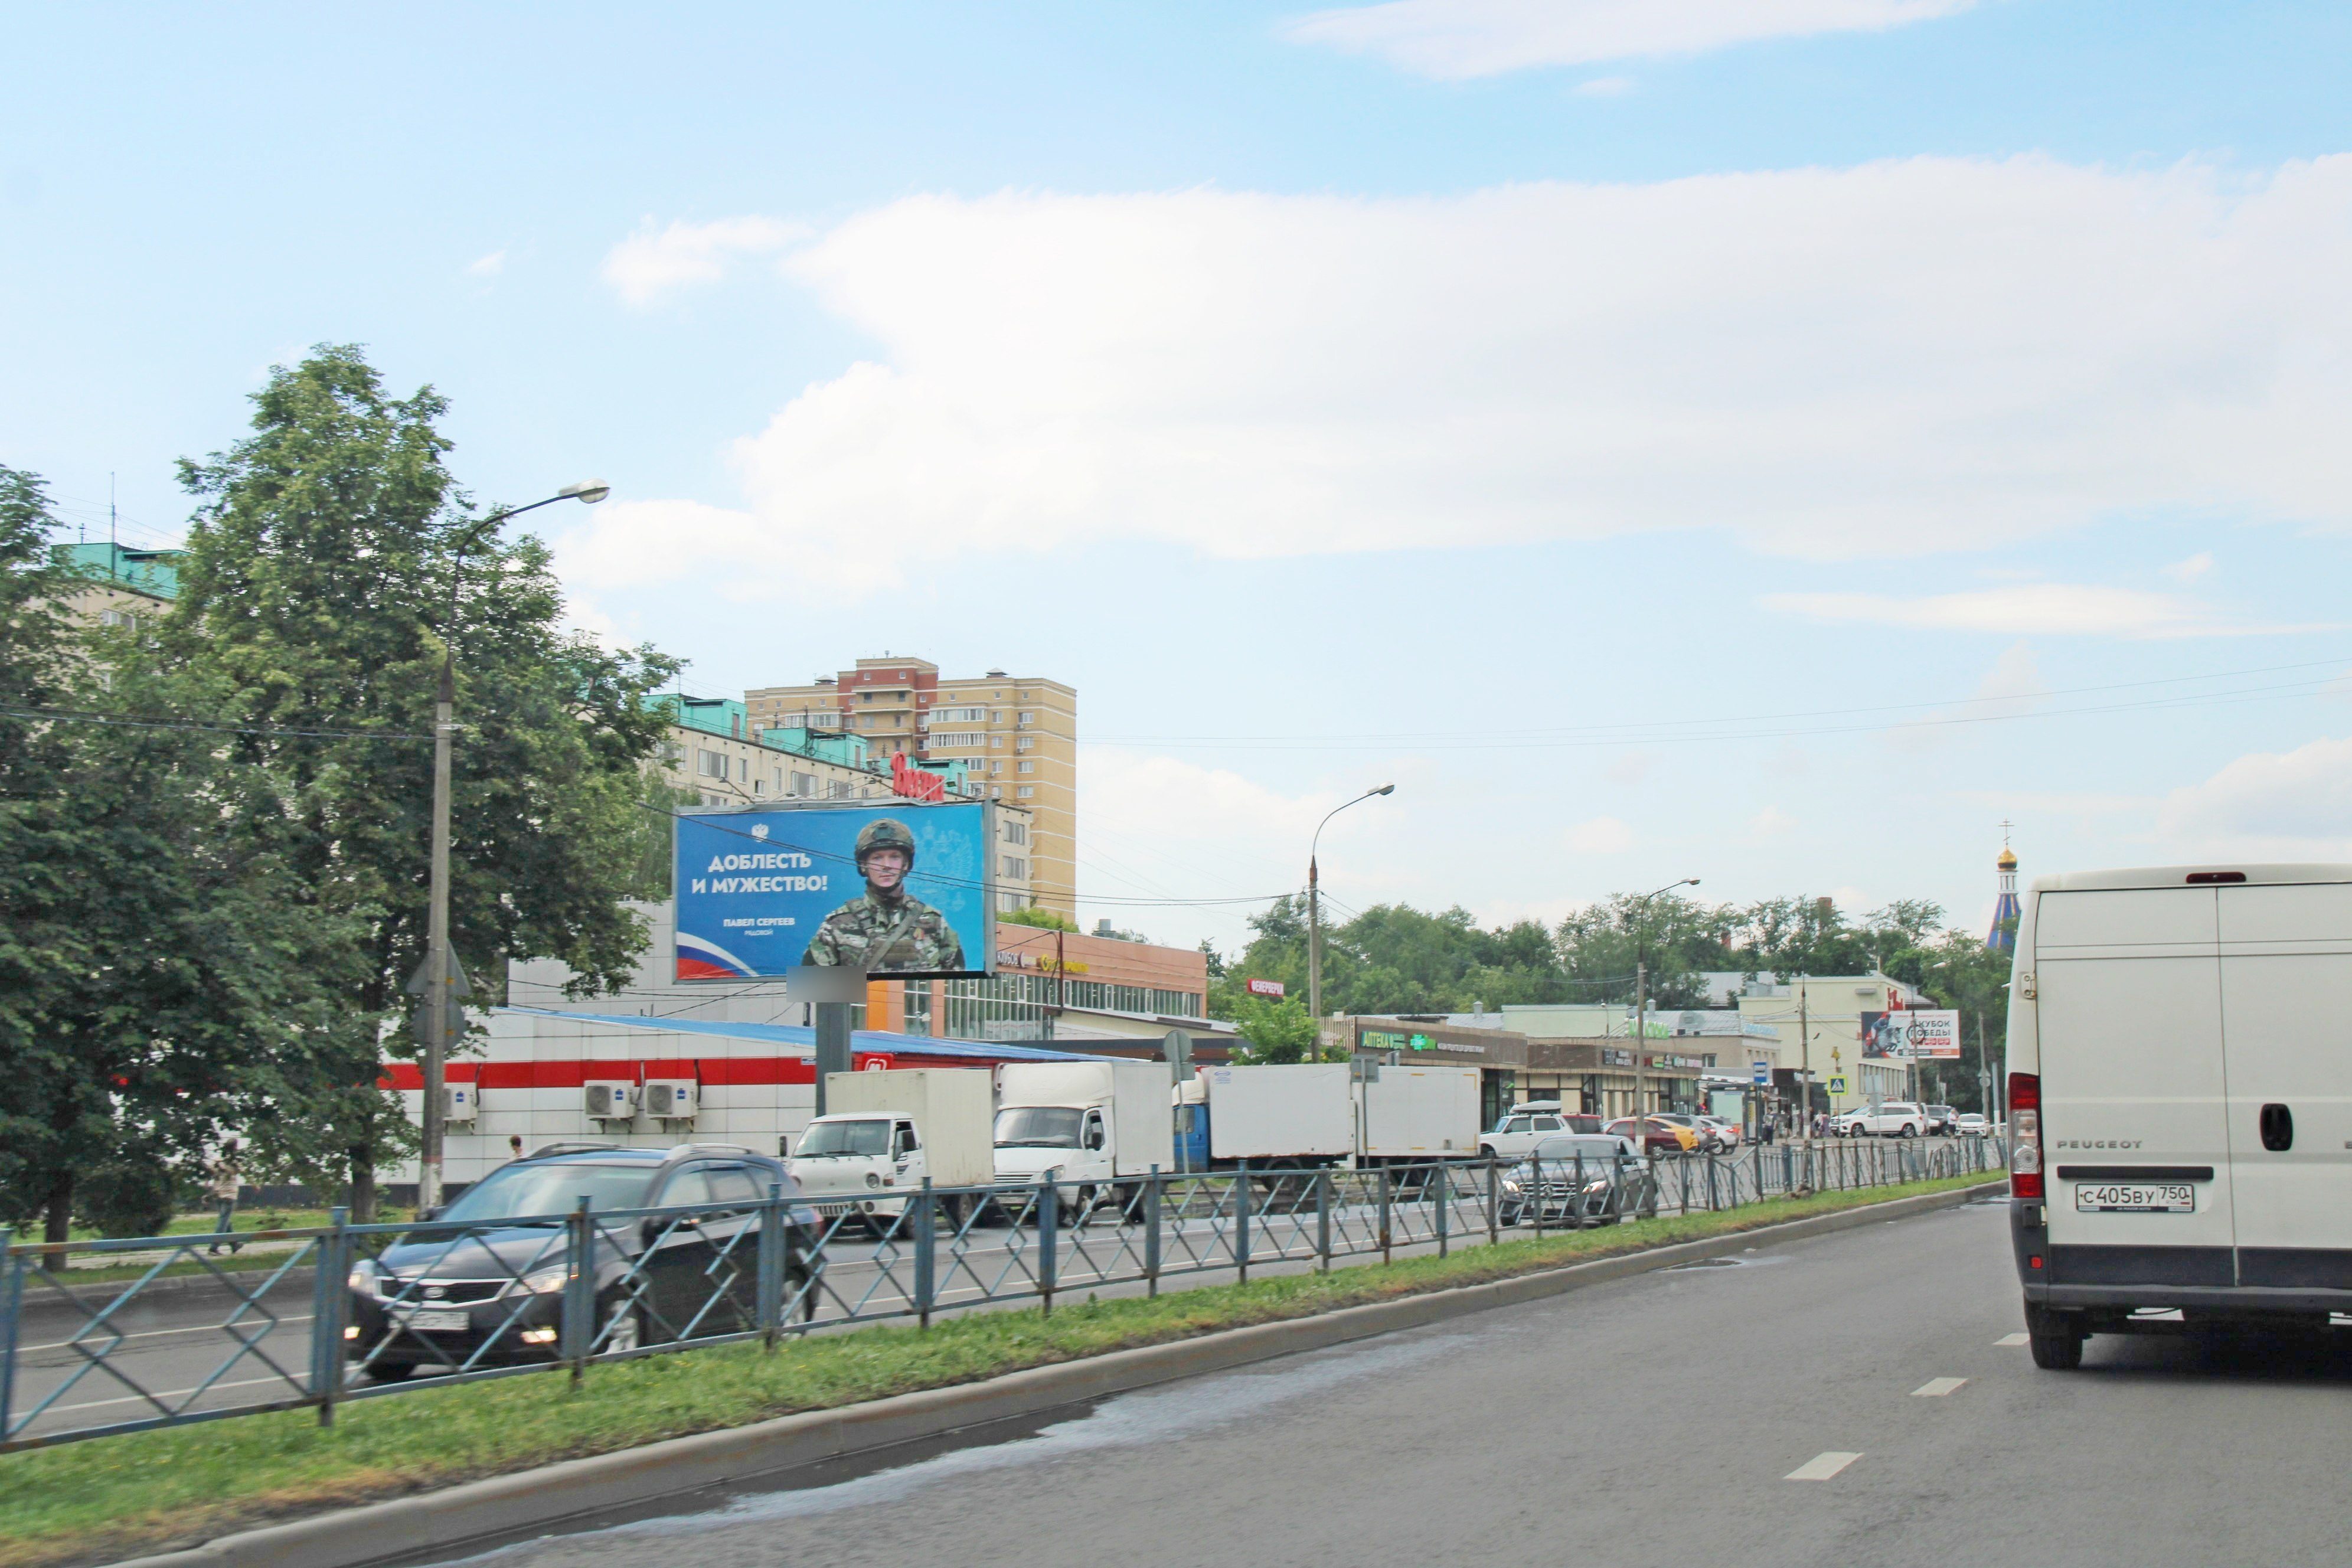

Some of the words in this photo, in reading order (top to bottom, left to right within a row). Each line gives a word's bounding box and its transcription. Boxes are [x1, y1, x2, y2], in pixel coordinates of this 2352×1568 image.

[708, 853, 812, 873] ДОБЛЕСТЬ
[691, 878, 706, 894] И
[711, 875, 828, 893] МУЖЕСТВО!
[723, 919, 754, 927] ПАВЕЛ
[756, 917, 795, 926] СЕРГЕЕВ
[1363, 1031, 1389, 1048] АПТЕКА
[2057, 1140, 2142, 1149] PEUGEOT
[2159, 1187, 2187, 1199] 750
